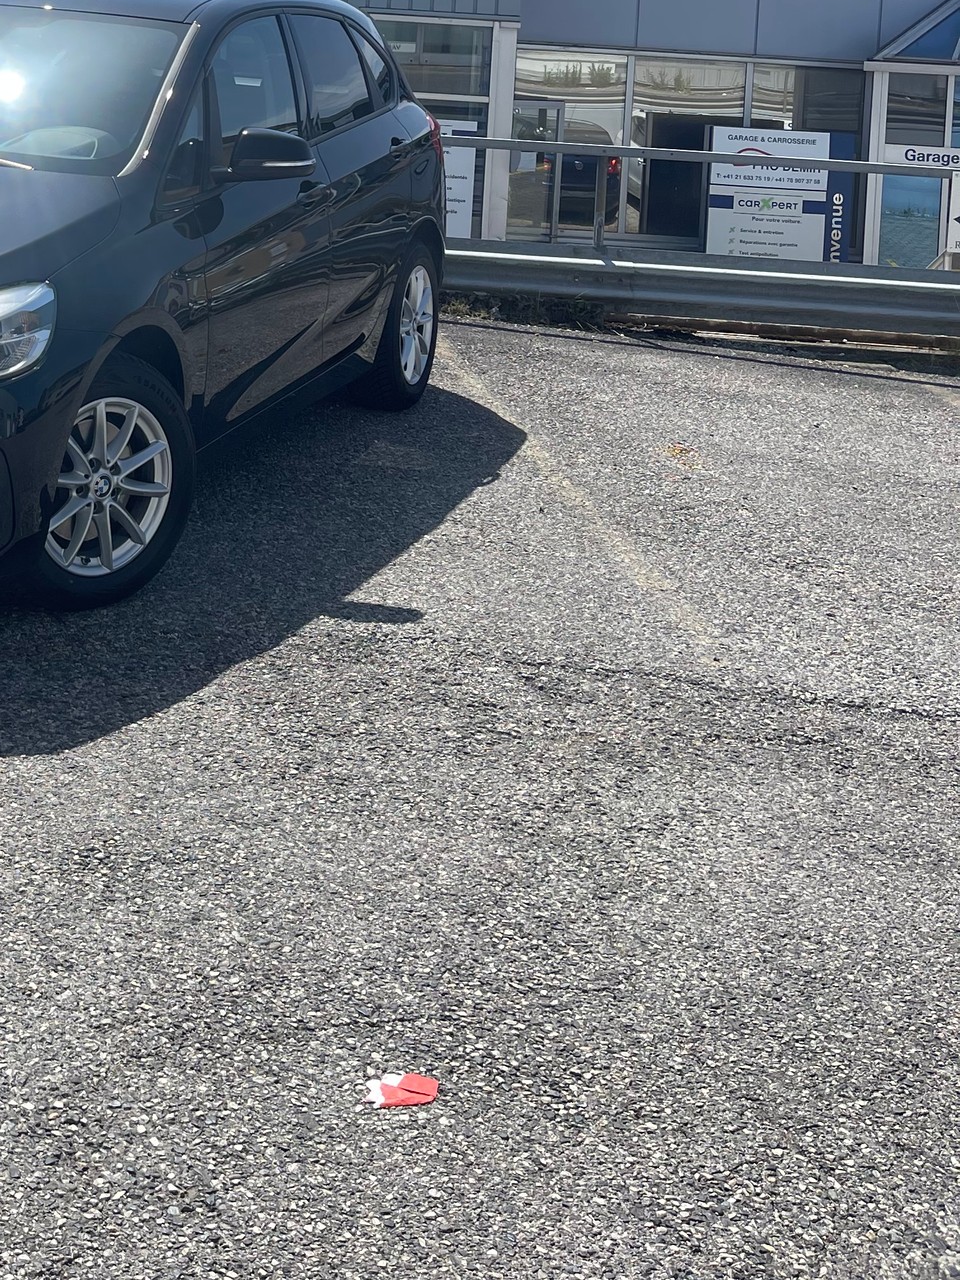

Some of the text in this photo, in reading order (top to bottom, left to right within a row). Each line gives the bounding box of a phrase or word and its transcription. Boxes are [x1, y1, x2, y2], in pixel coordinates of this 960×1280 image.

[727, 134, 758, 142] GARAGE
[767, 136, 817, 145] CARROSSERIE
[904, 148, 960, 166] Garage
[830, 193, 843, 262] nvenue
